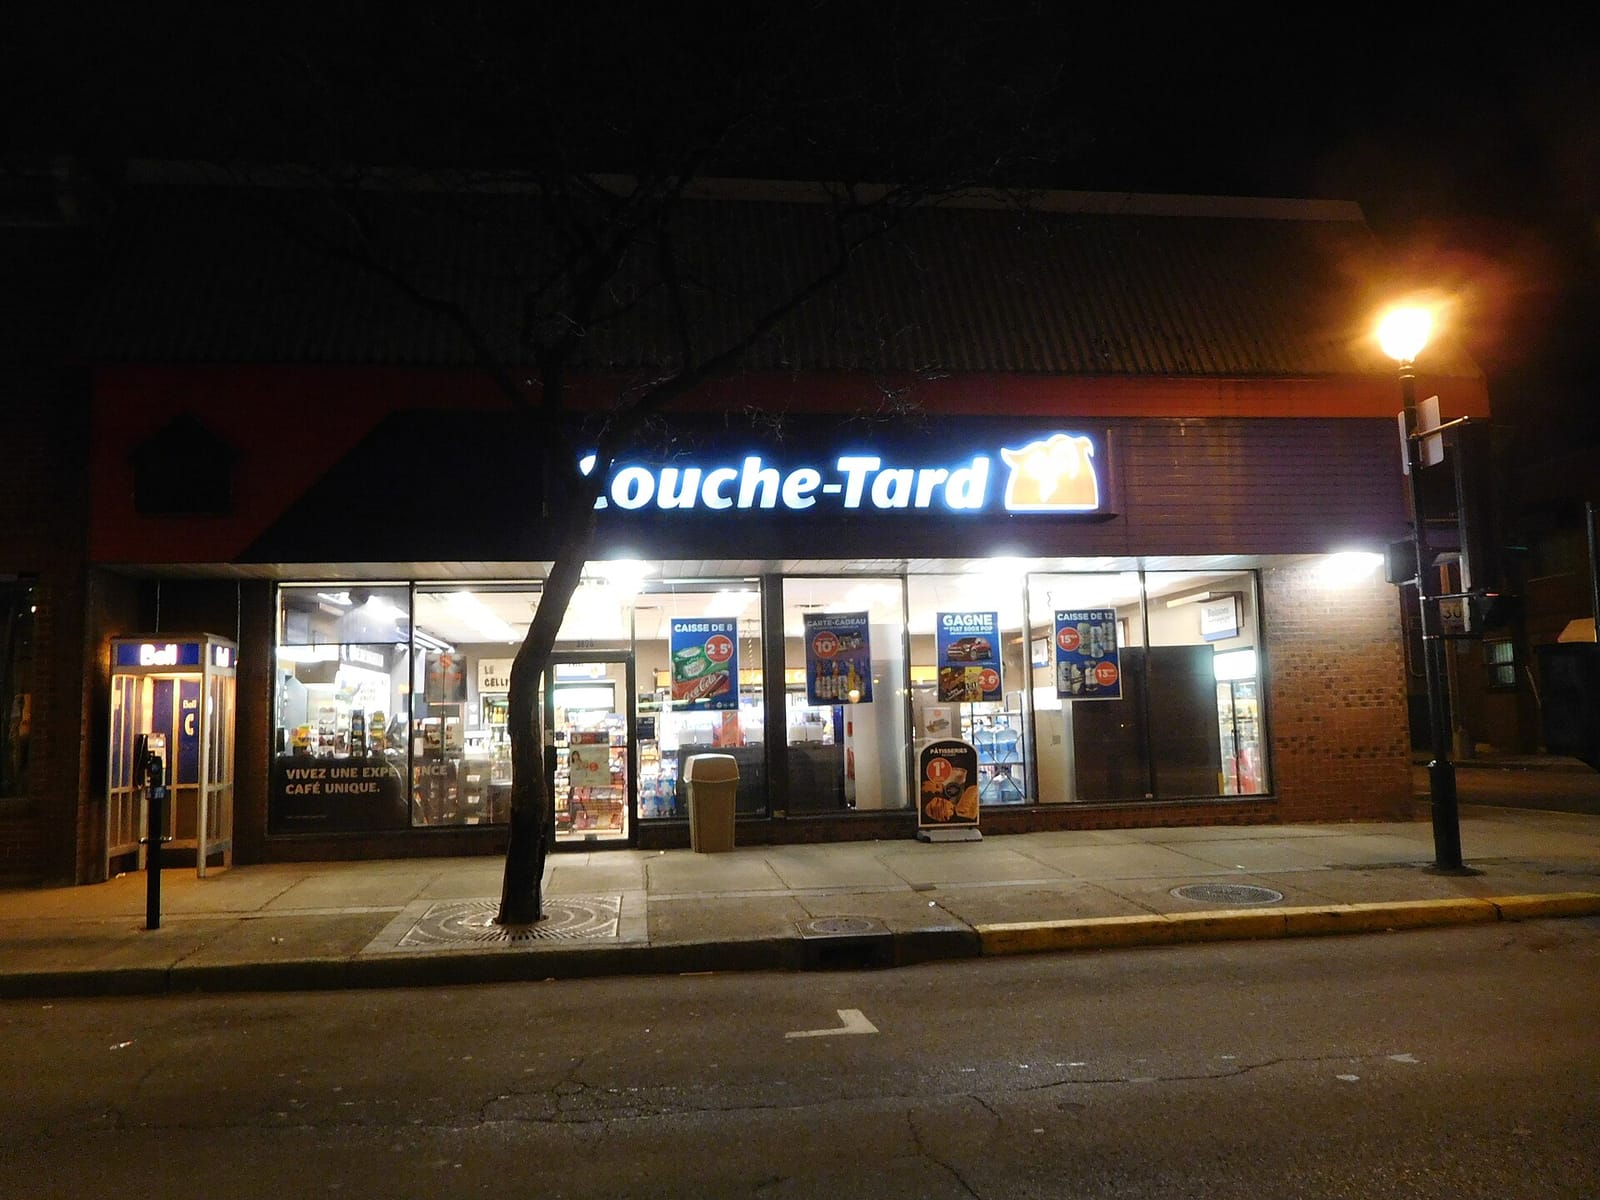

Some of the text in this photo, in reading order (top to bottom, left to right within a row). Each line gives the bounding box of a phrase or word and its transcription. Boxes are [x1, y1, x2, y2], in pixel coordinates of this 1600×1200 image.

[942, 613, 993, 626] GAGNE
[1056, 612, 1113, 621] CAISSE DE 12
[674, 623, 709, 633] CAISSE
[711, 623, 725, 632] DE
[285, 768, 327, 780] VIVEZ
[330, 767, 359, 779] UNE
[285, 781, 381, 795] CAFÉ UNIQUE.
